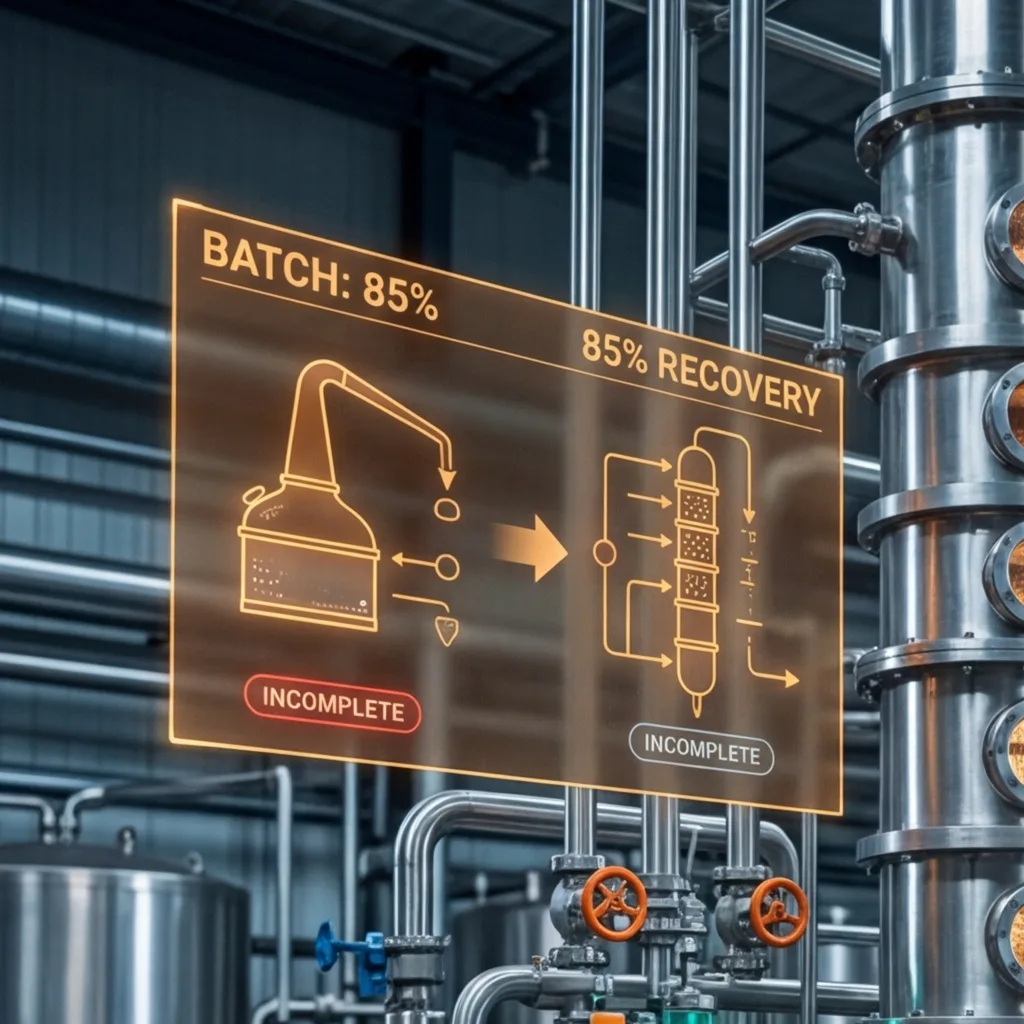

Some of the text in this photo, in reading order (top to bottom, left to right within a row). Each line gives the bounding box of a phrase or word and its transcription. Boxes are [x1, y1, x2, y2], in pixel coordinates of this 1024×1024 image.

[203, 228, 439, 321] BATCH: 85%
[582, 328, 822, 417] 85% RECOVERY
[262, 684, 405, 724] INCOMPLETE
[643, 732, 761, 766] INCOMPLETE
